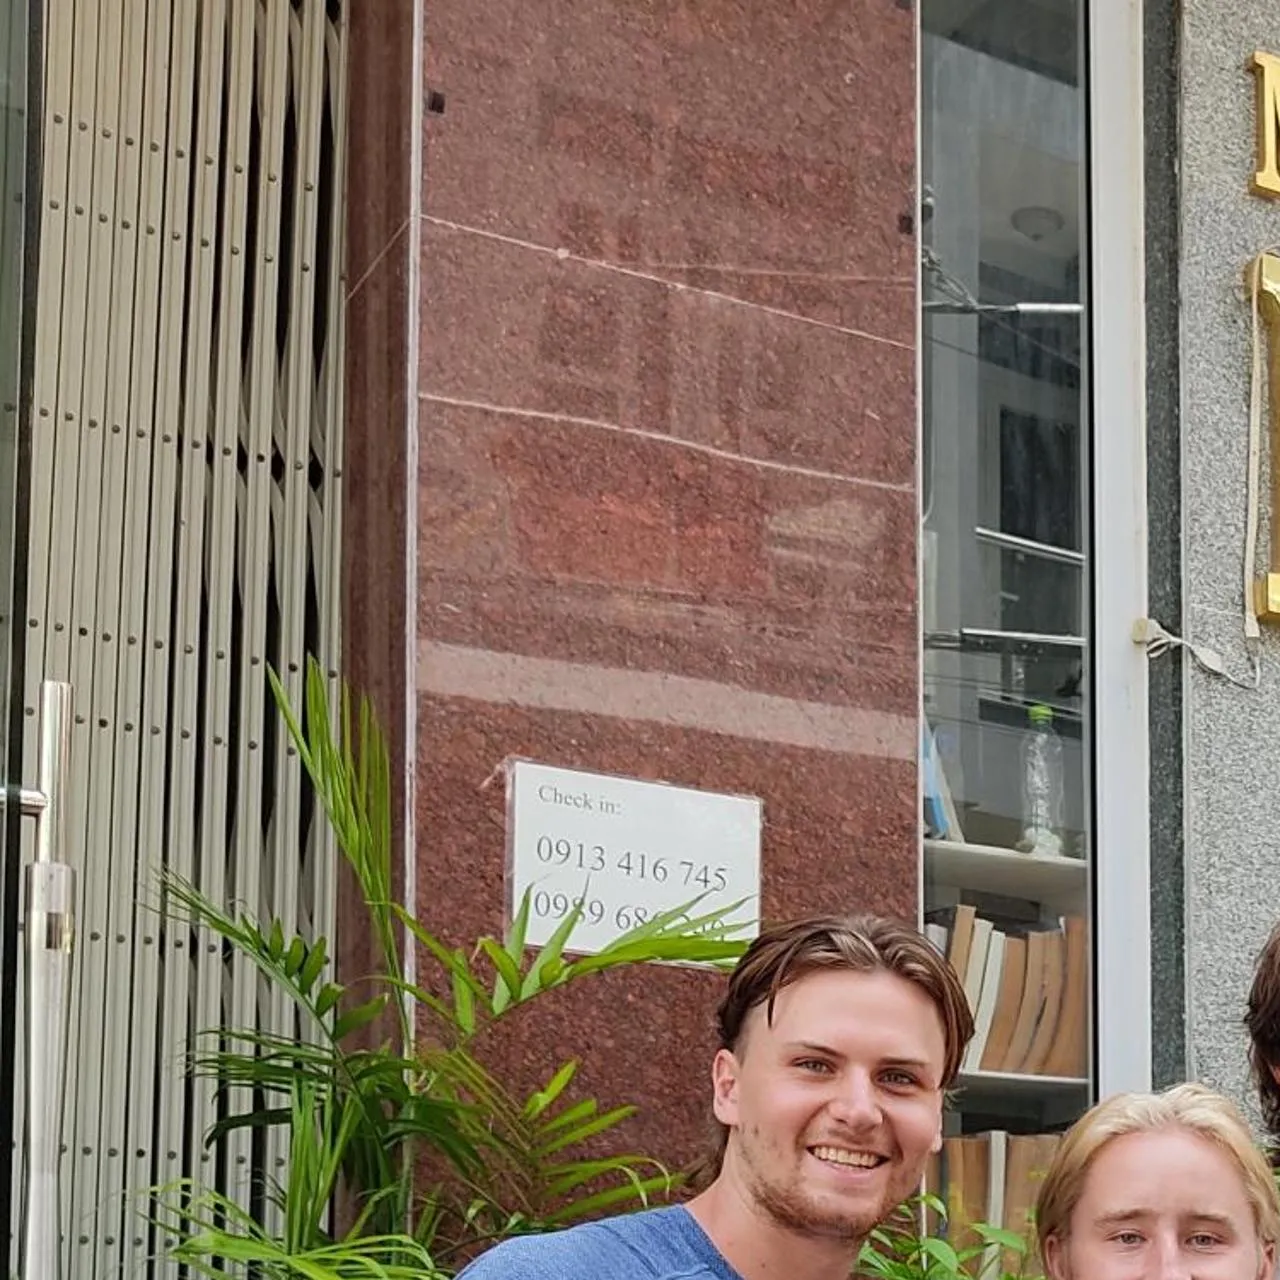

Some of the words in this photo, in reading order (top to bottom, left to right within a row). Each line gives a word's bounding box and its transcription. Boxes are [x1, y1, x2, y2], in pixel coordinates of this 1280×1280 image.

[538, 784, 593, 812] Check
[599, 801, 623, 816] in:
[537, 835, 606, 872] 0913
[617, 851, 668, 884] 416
[680, 860, 727, 892] 745
